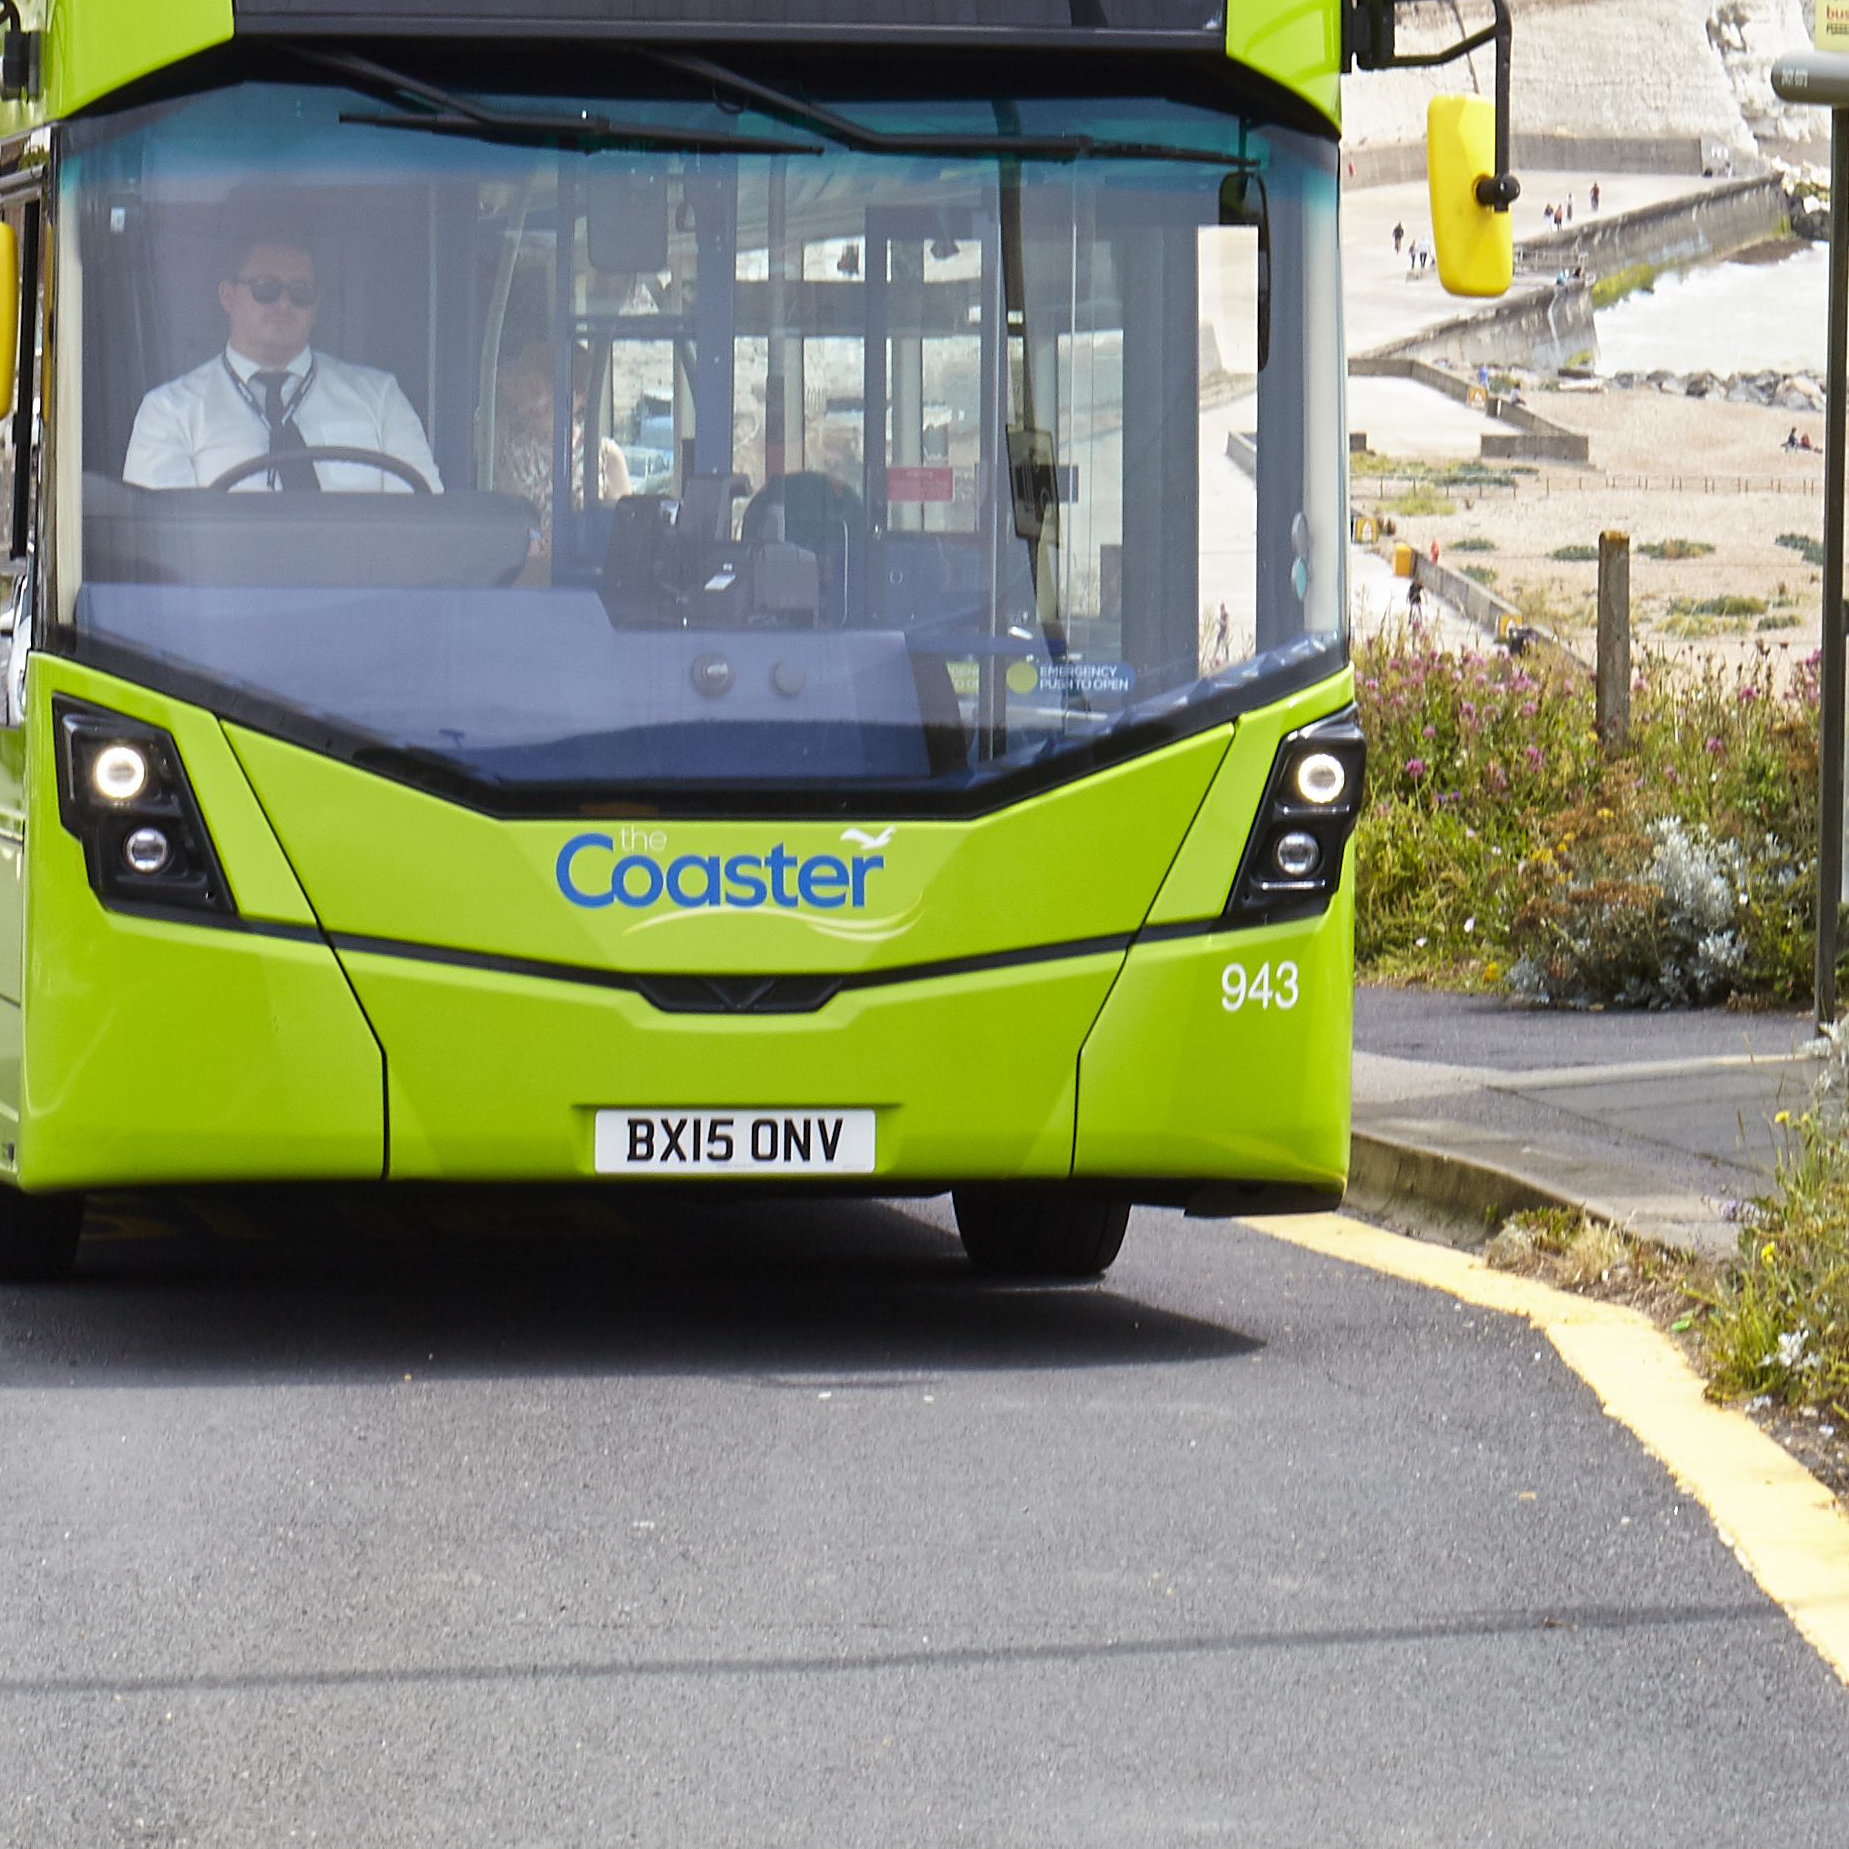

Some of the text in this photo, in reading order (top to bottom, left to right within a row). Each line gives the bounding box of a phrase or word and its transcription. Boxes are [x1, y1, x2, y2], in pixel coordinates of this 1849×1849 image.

[1826, 5, 1849, 20] bus
[1040, 665, 1117, 678] EMERGENCY
[1093, 677, 1129, 691] OPEN
[619, 824, 667, 852] the
[555, 831, 885, 909] Coaster
[1222, 959, 1299, 1012] 943
[626, 1117, 844, 1163] BX15 ONV
